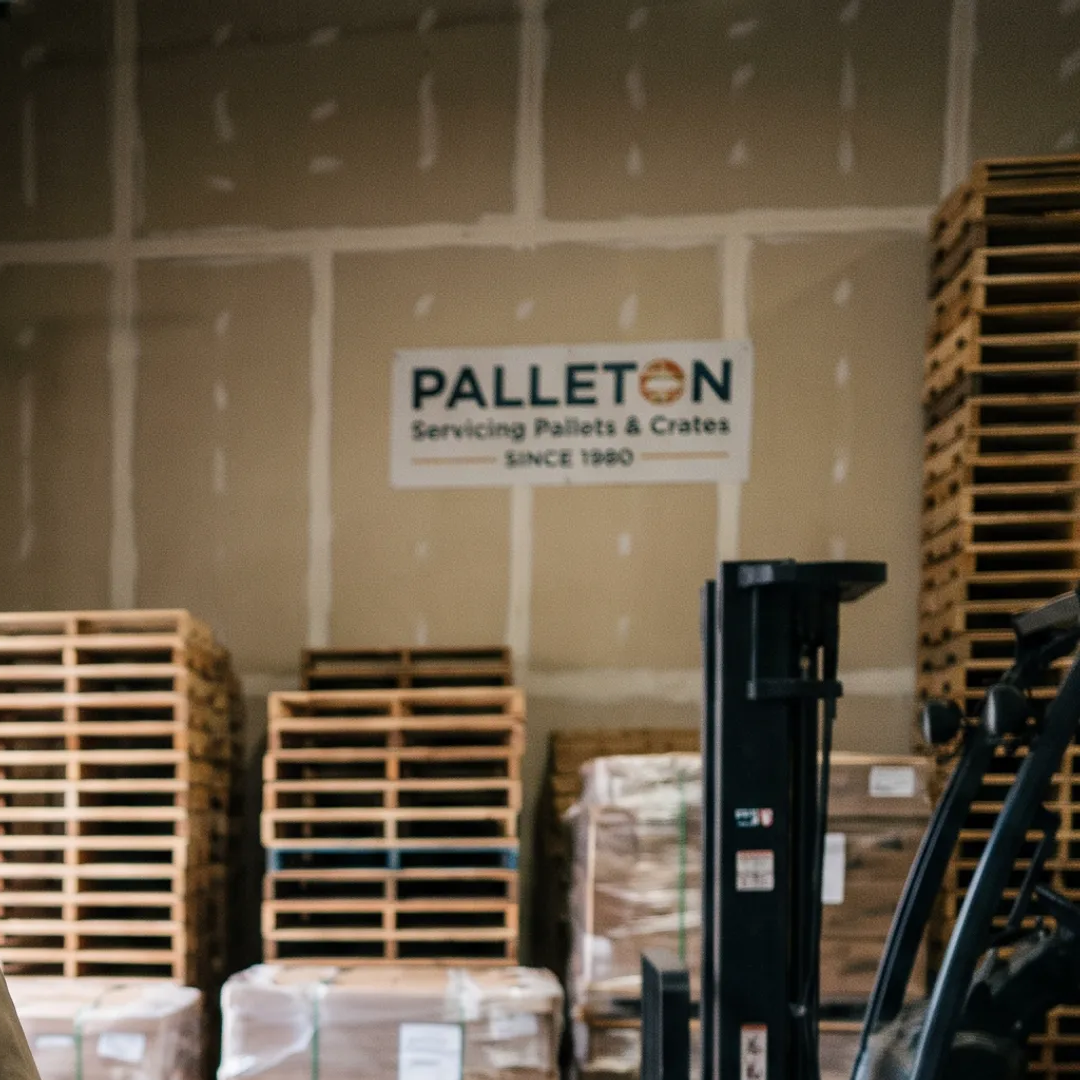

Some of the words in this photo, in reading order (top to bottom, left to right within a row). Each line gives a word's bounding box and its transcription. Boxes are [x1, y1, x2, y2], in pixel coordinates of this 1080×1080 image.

[411, 357, 733, 410] PALLETON
[411, 418, 526, 443] Servicing
[534, 416, 617, 438] Pallets
[624, 414, 641, 436] &
[650, 414, 732, 436] Crates
[504, 449, 573, 469] SINCE
